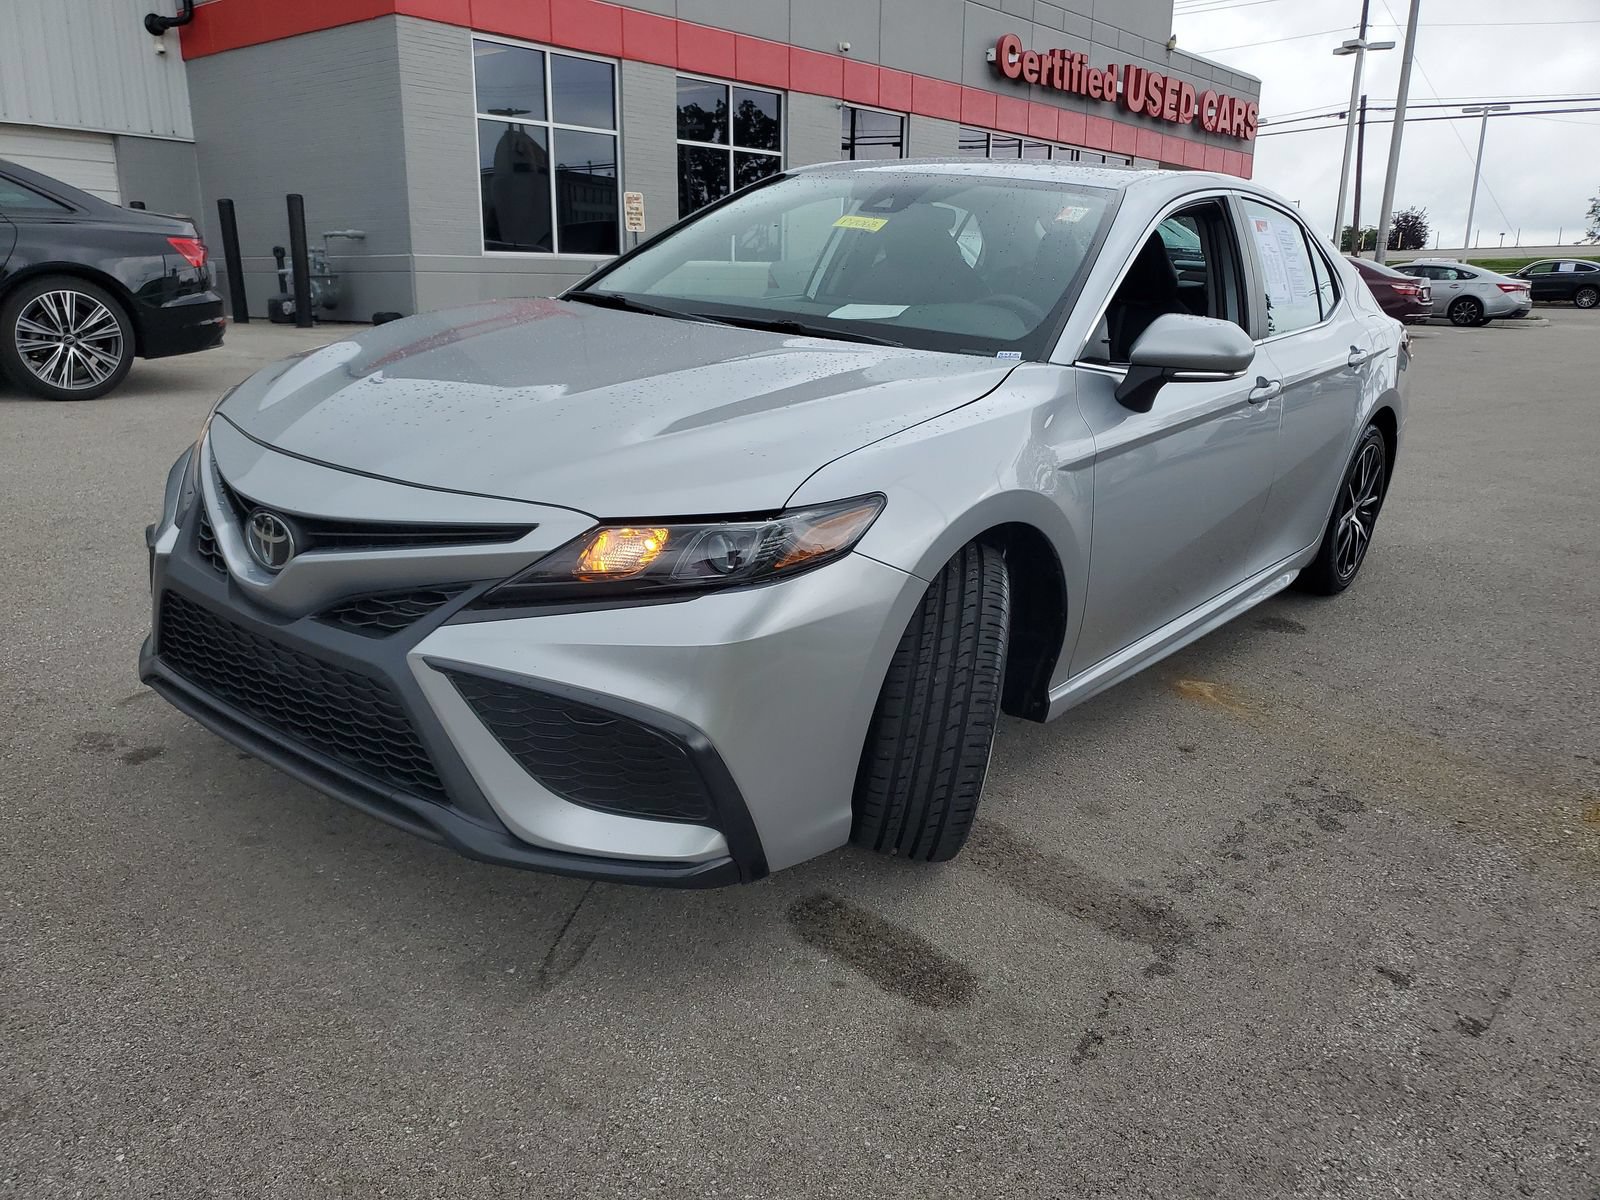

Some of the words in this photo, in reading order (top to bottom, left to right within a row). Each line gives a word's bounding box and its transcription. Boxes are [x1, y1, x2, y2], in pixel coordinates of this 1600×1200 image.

[997, 33, 1118, 102] Certified
[1124, 64, 1196, 125] USED
[1201, 89, 1259, 140] CARS
